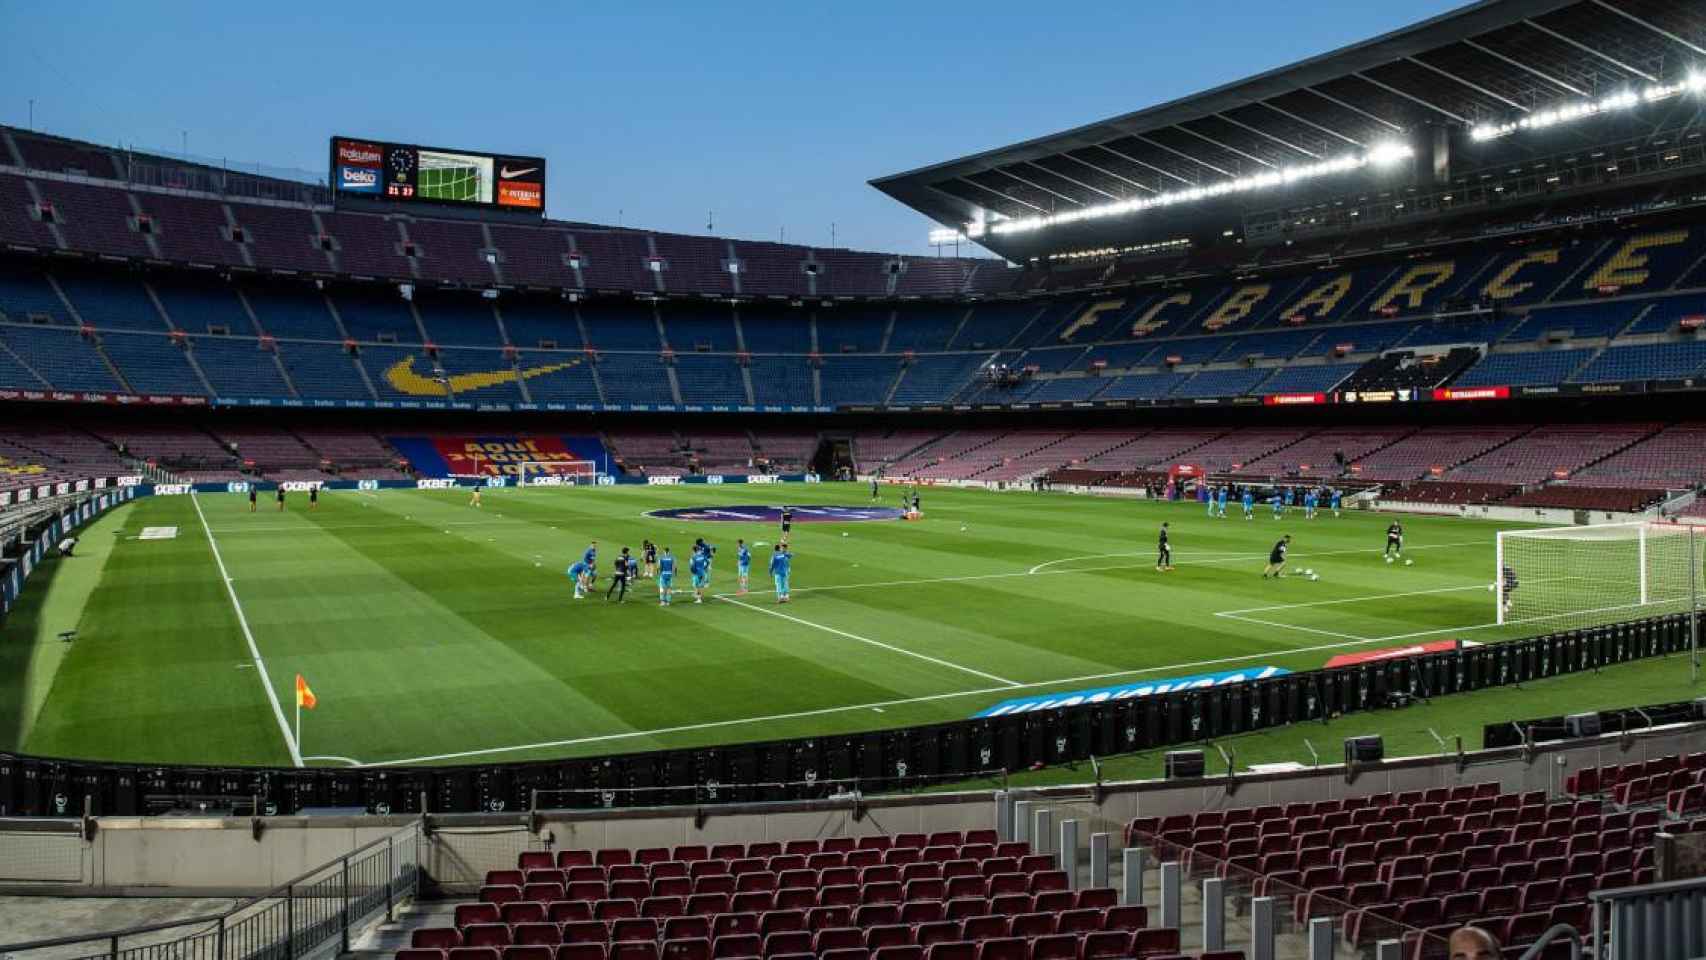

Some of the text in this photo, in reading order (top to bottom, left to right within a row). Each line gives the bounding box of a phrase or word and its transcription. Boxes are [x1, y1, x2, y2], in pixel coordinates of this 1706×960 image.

[343, 167, 376, 182] beko
[416, 478, 457, 489] 1XBET
[648, 475, 681, 485] 1XBET
[747, 474, 779, 484] 1XBET
[154, 483, 192, 495] 1XBET
